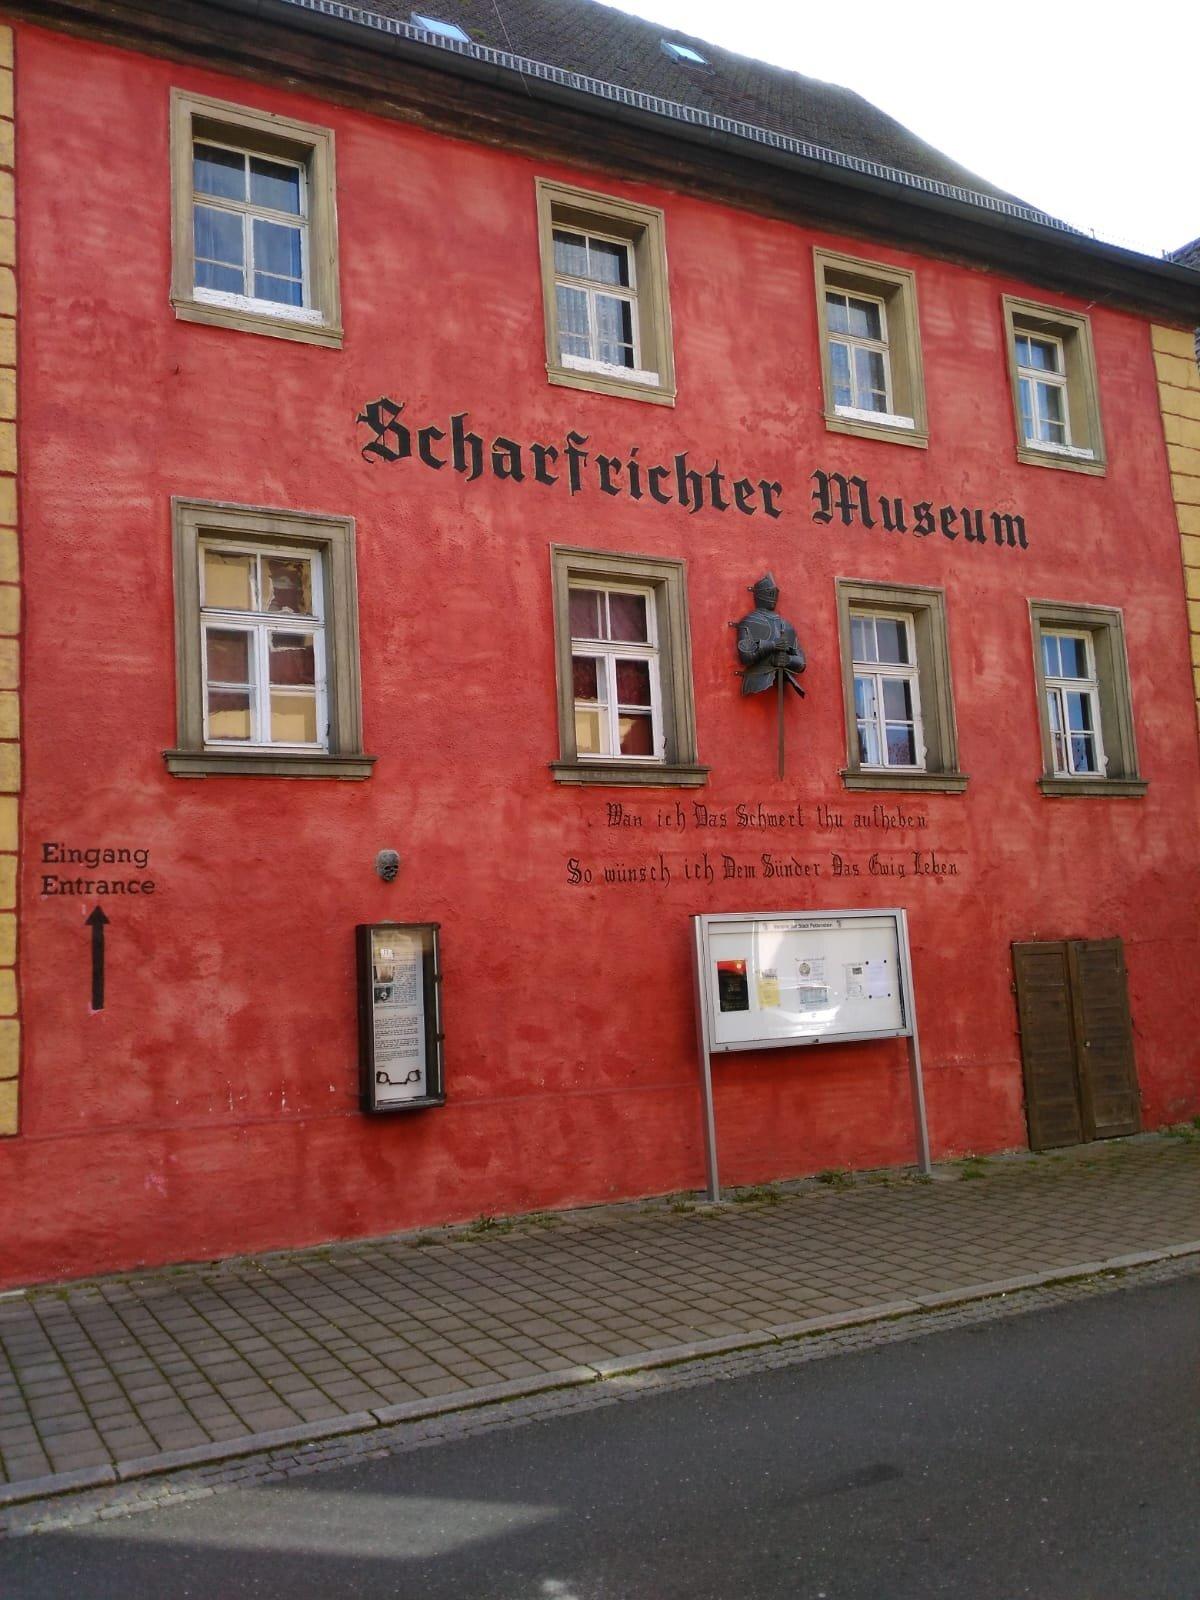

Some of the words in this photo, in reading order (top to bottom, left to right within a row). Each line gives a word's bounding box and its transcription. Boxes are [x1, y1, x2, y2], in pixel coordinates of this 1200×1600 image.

[356, 397, 783, 519] Scharfrichter
[811, 467, 1029, 550] Museum
[657, 801, 686, 833] ich
[692, 801, 727, 829] Das
[735, 803, 805, 833] Schwert
[816, 803, 844, 833] thu
[41, 842, 150, 869] Eingang
[567, 857, 593, 885] So
[604, 853, 671, 889] wünsch
[684, 852, 714, 886] ich
[721, 853, 756, 881] Dem
[761, 853, 821, 879] Sünder
[830, 851, 860, 878] Das
[868, 852, 906, 879] Ewig
[911, 849, 959, 877] Leben
[41, 874, 156, 896] Entrance
